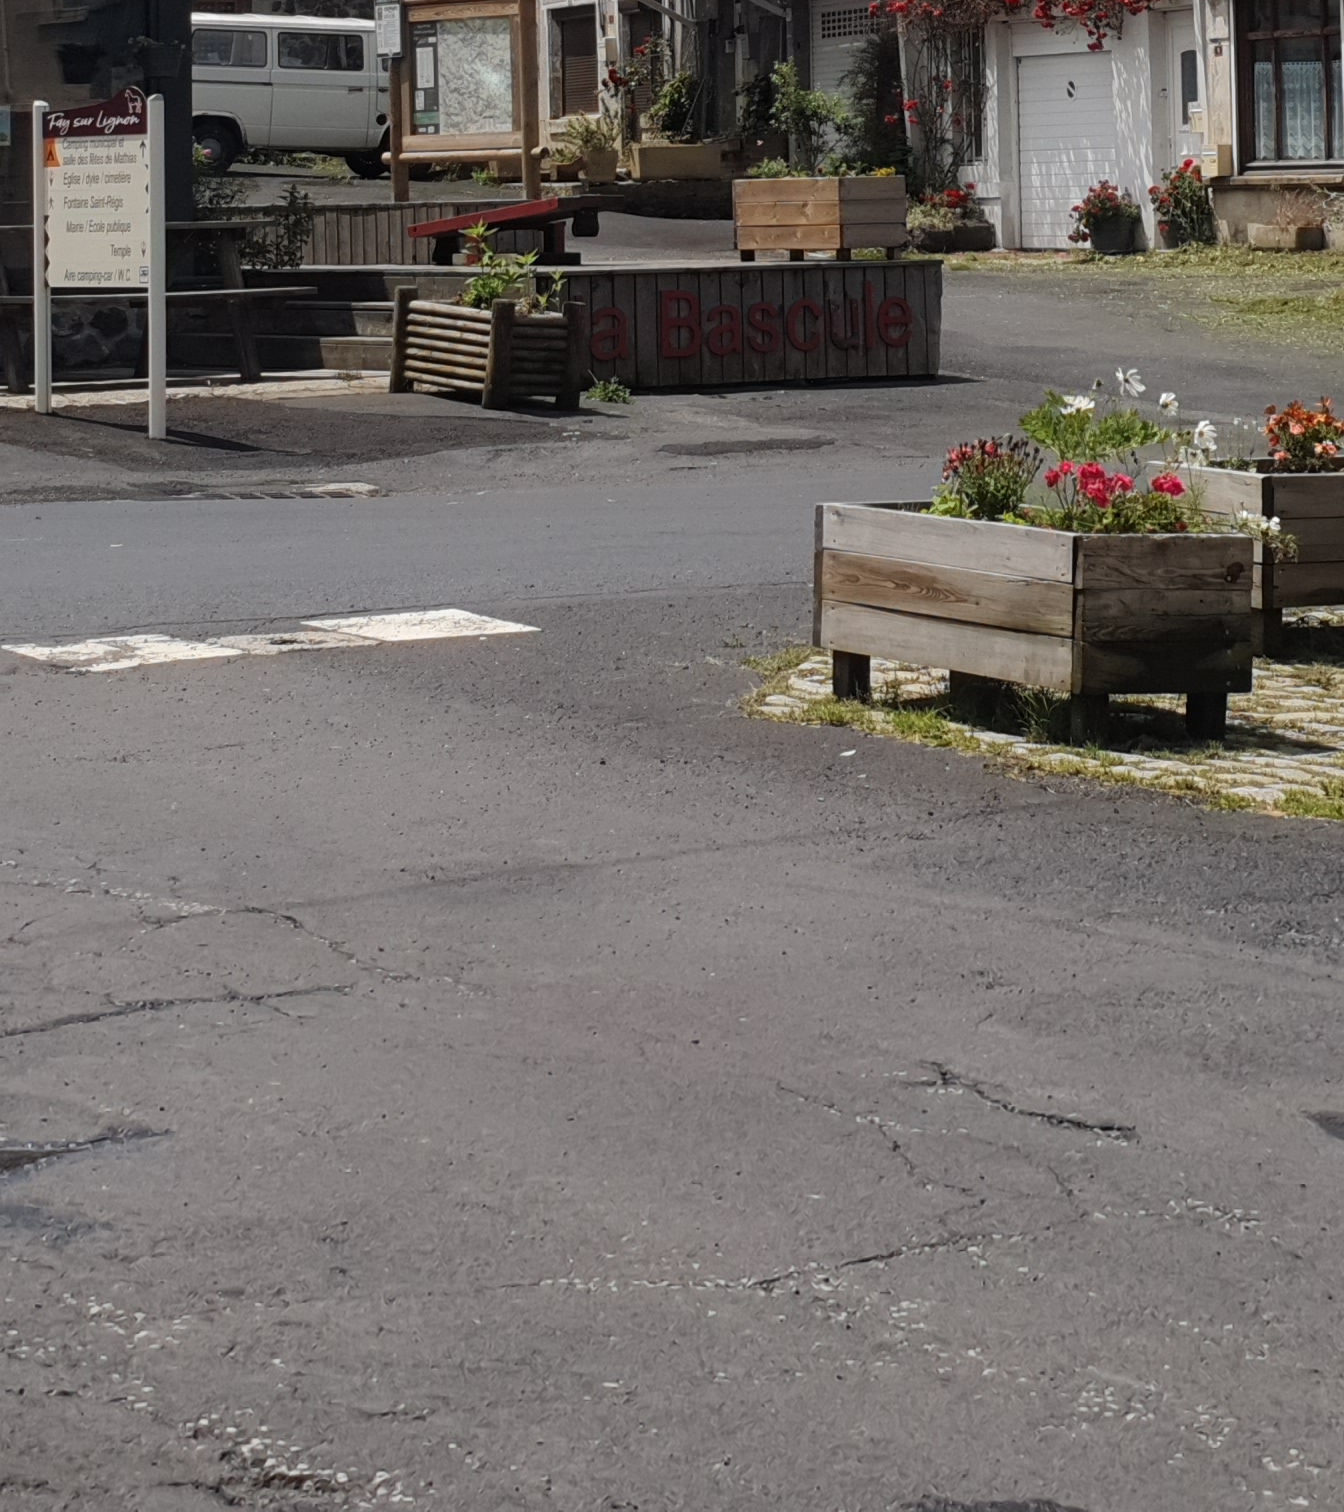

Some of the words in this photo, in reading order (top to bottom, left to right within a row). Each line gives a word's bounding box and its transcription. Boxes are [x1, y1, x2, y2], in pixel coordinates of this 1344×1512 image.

[47, 112, 70, 135] Fay
[73, 116, 94, 127] sur
[96, 110, 140, 134] Lignon
[77, 154, 88, 165] des
[104, 153, 113, 164] de
[63, 196, 88, 209] Fontaine
[110, 244, 131, 259] Temple
[659, 280, 913, 359] Bascule
